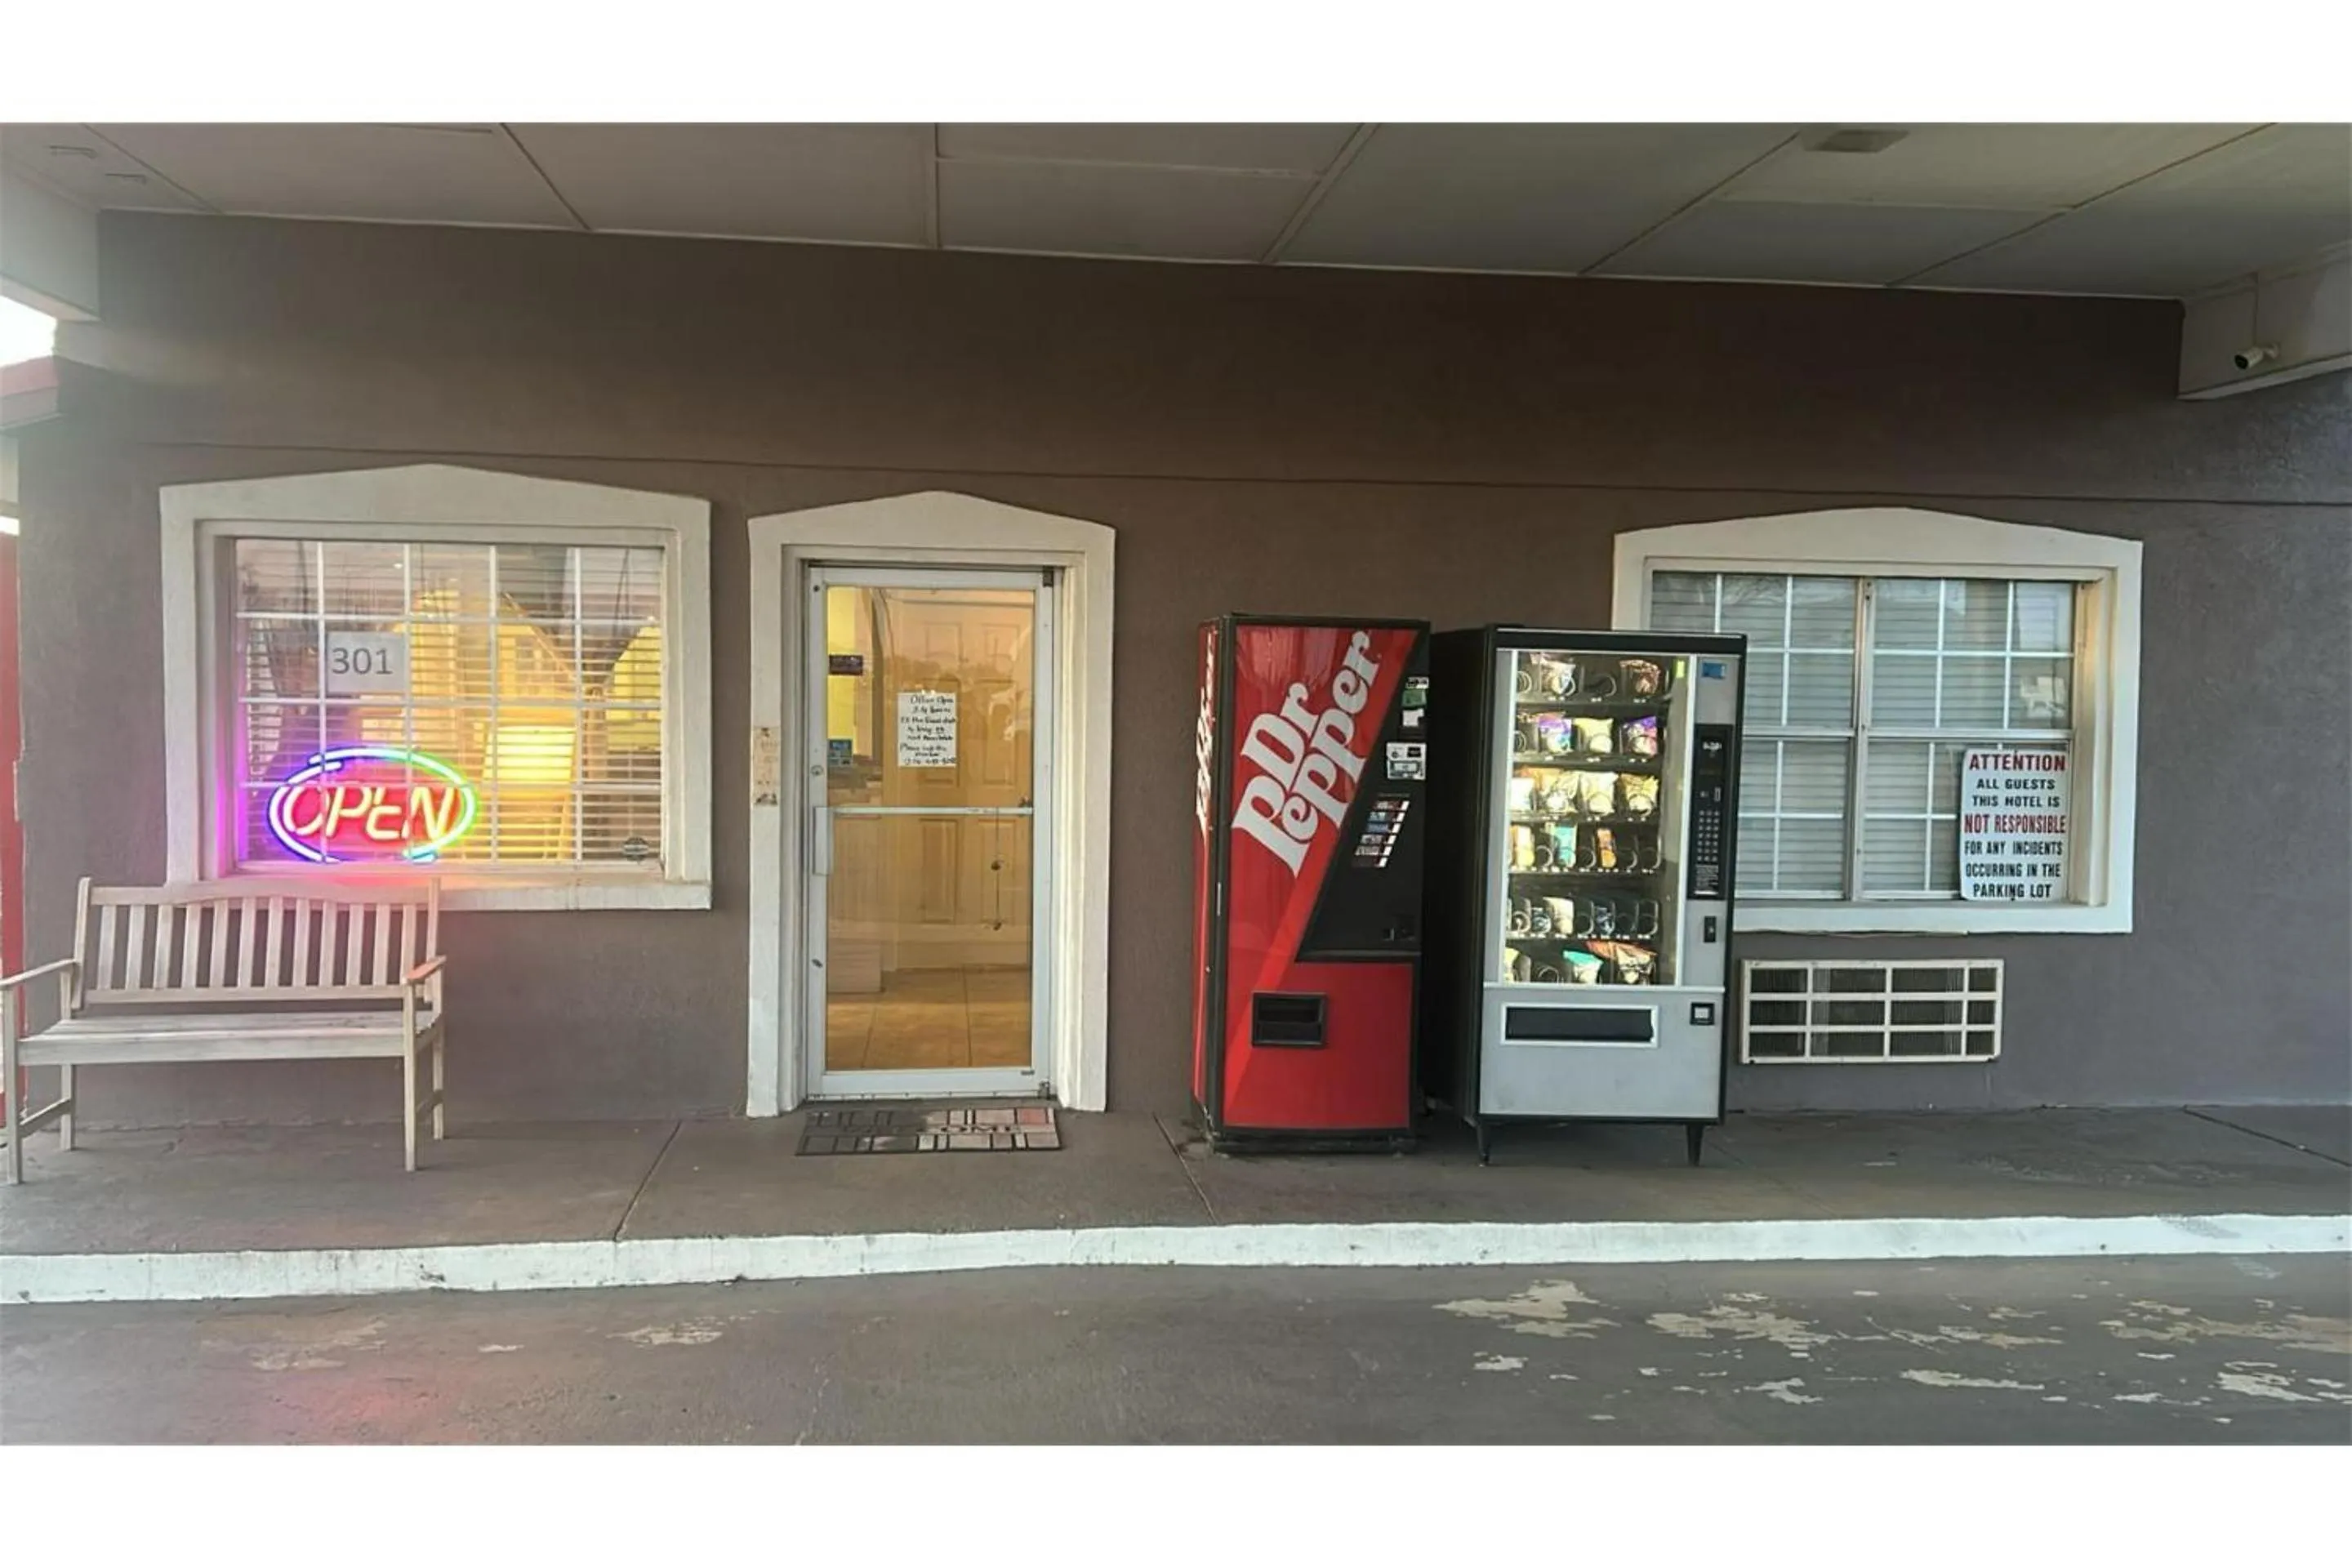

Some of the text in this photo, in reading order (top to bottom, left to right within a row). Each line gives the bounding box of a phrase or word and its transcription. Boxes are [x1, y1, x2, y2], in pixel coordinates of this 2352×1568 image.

[332, 648, 393, 675] 301
[1240, 681, 1320, 793] Dr
[1231, 630, 1380, 880] Pepper
[1969, 753, 2066, 772] ATTENTION
[1976, 778, 2056, 790] ALL GUESTS
[1972, 795, 1998, 807] THIS
[2047, 796, 2060, 808] IS
[282, 786, 457, 841] OPEN
[1964, 813, 2066, 834] NOT RESPONSIBLE
[1964, 840, 2063, 856] FOR ANY INCIDENTS
[1965, 863, 2061, 878] OCCURRING IN THE
[1973, 883, 2053, 898] PARKING LOT
